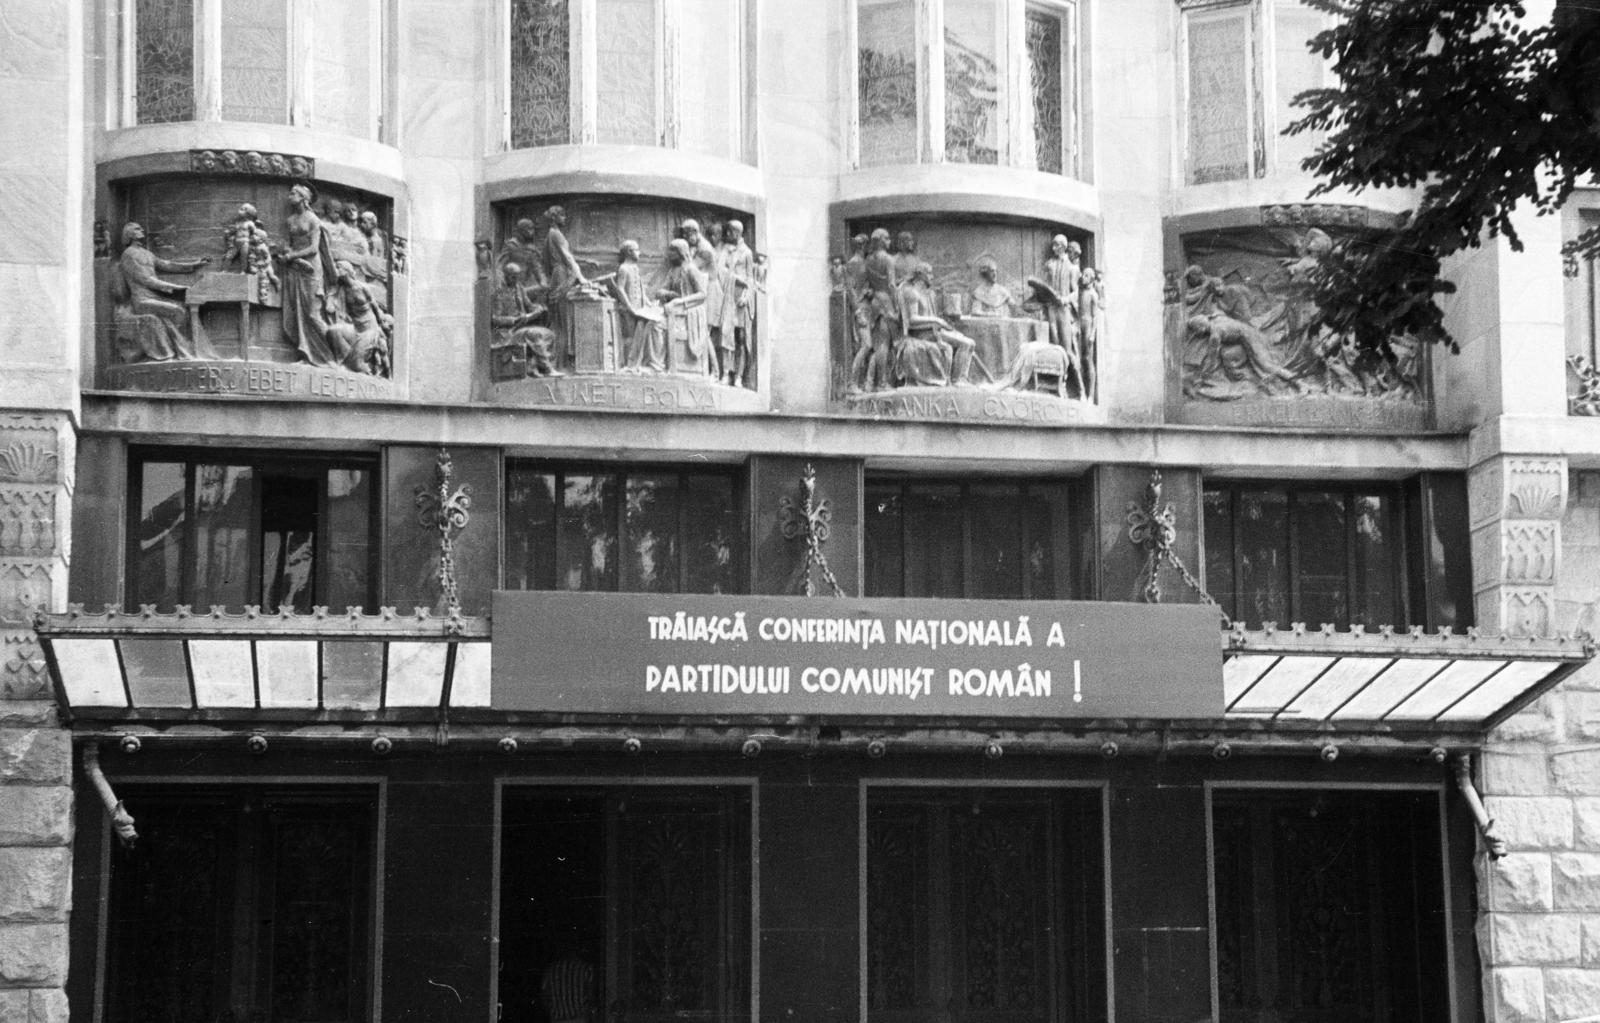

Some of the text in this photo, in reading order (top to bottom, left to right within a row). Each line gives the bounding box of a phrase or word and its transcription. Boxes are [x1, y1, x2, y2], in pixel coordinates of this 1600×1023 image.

[648, 611, 1065, 650] TRĂIASCĂ CONFERINȚA NAȚIONALĂ A
[646, 664, 790, 694] PARTIDULUI
[801, 666, 934, 701] COMUNIST
[949, 662, 1051, 698] ROMÂN
